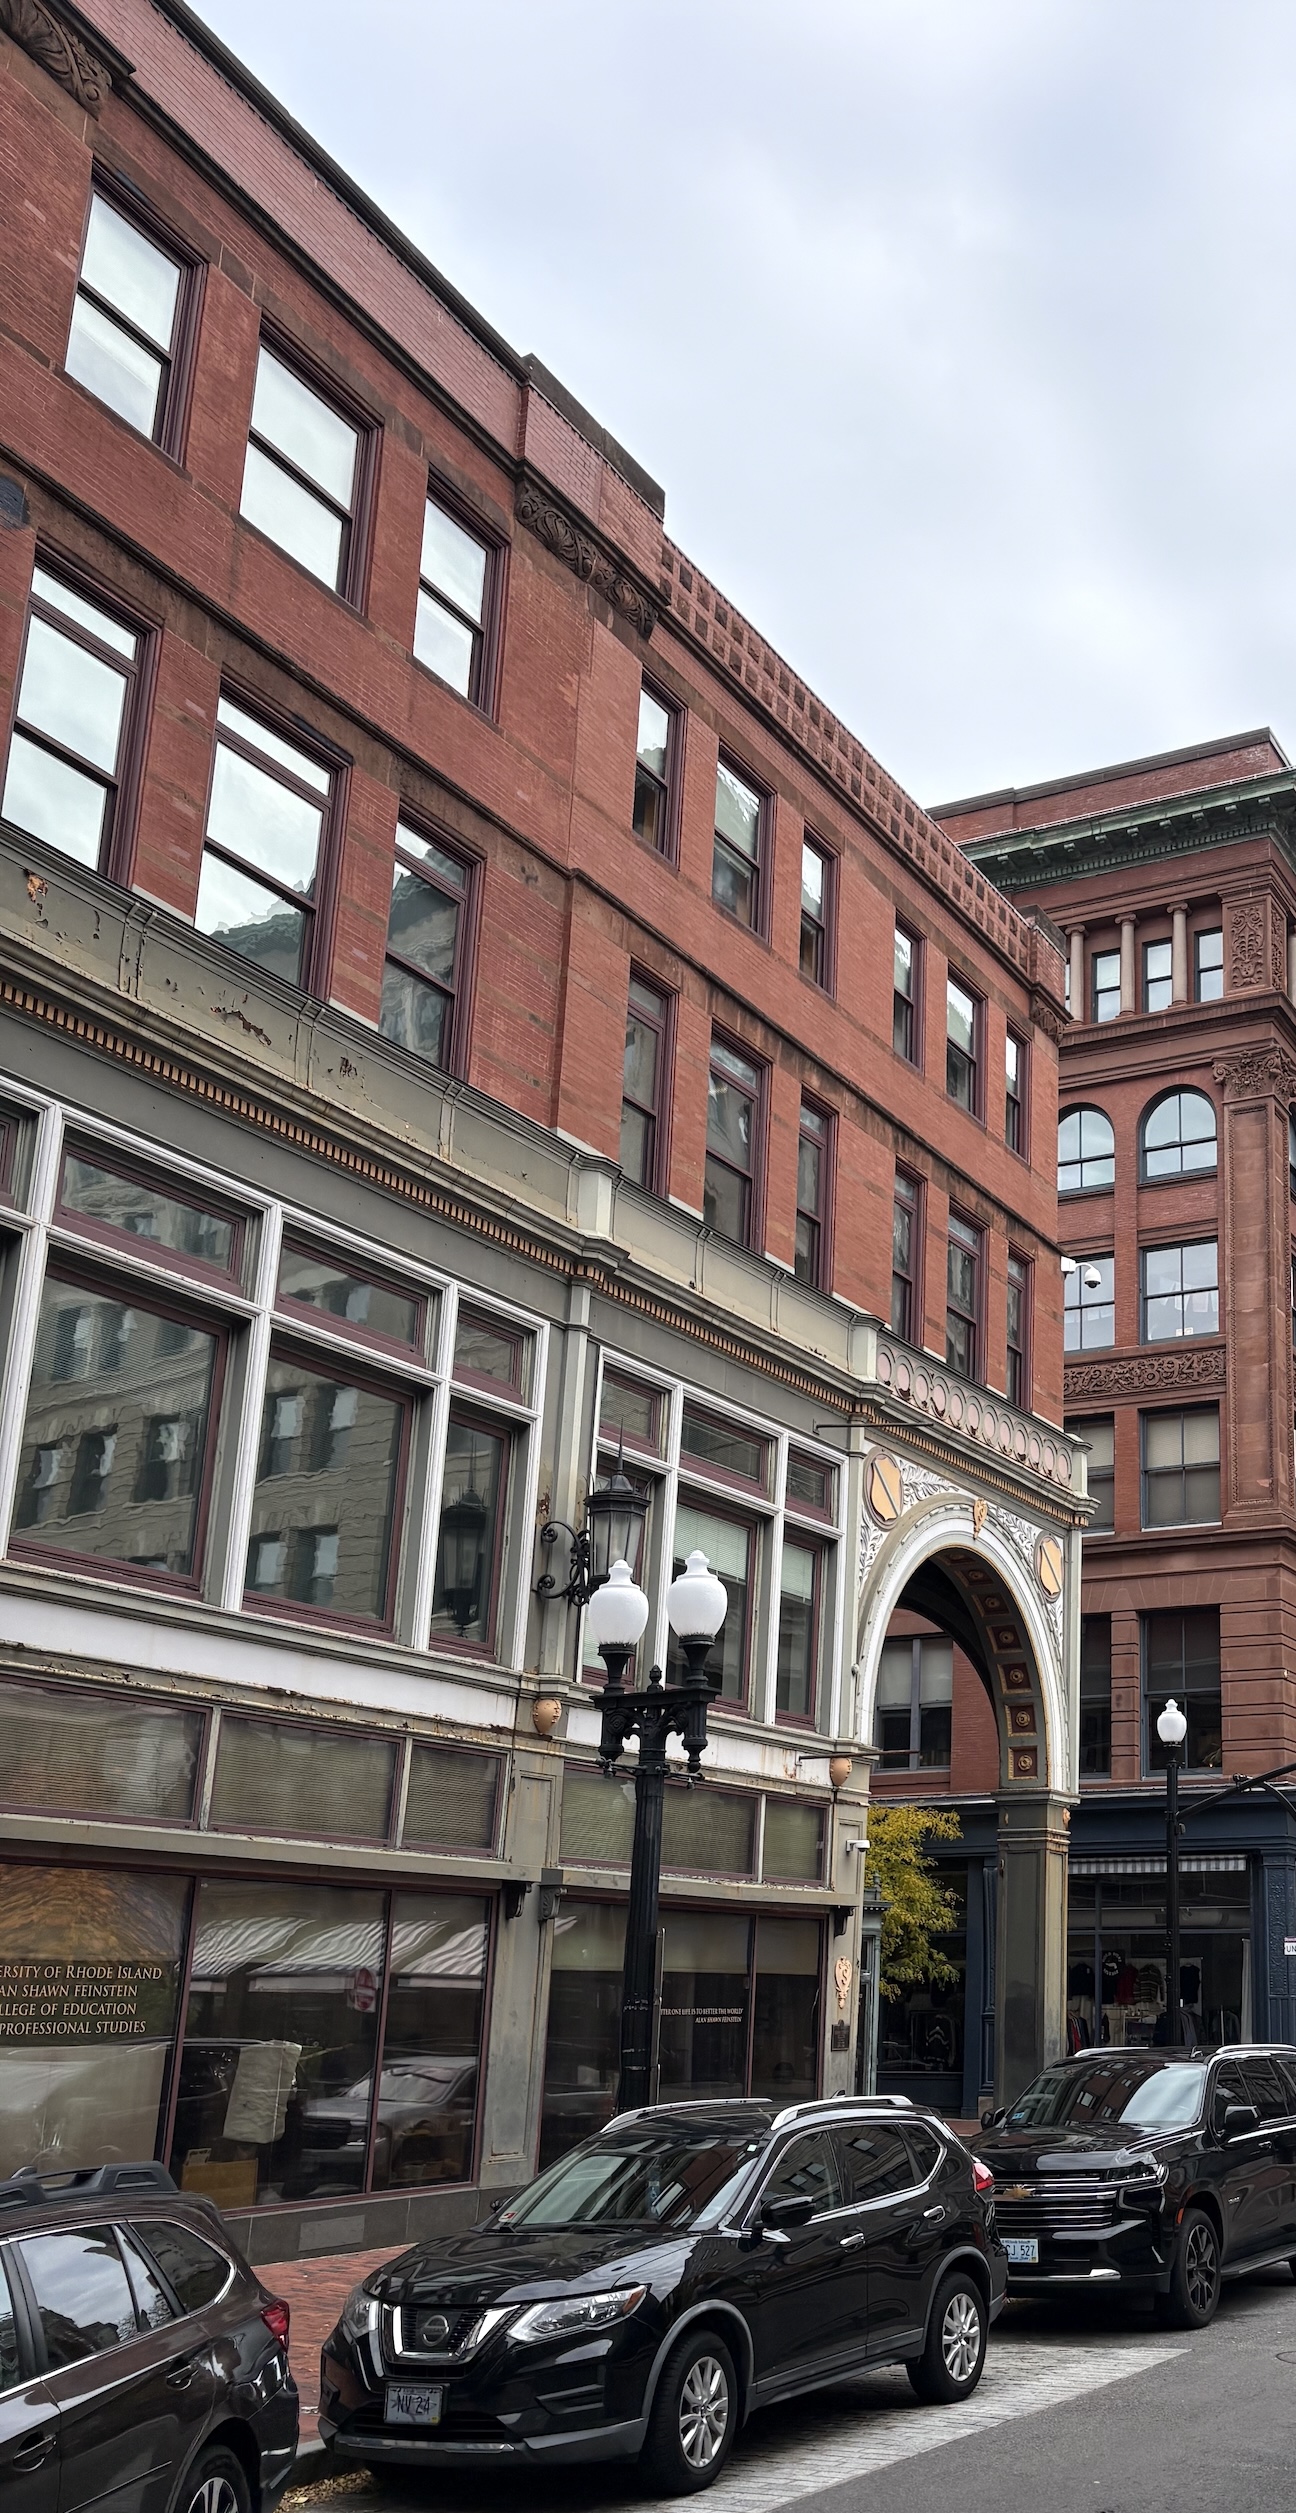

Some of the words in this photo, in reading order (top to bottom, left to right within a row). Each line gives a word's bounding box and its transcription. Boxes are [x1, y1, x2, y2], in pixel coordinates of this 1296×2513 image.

[44, 1966, 62, 1979] OF
[66, 1965, 113, 1979] RHODE
[117, 1965, 162, 1980] ISLAND
[22, 1984, 69, 1998] SHAWN
[74, 1984, 138, 1997] FEINSTEIN
[40, 2003, 58, 2016] OF
[63, 2003, 137, 2016] EDUCATION
[0, 2021, 91, 2035] PROFESSIONAL
[95, 2020, 147, 2034] STUDIES
[1020, 2244, 1035, 2257] 527
